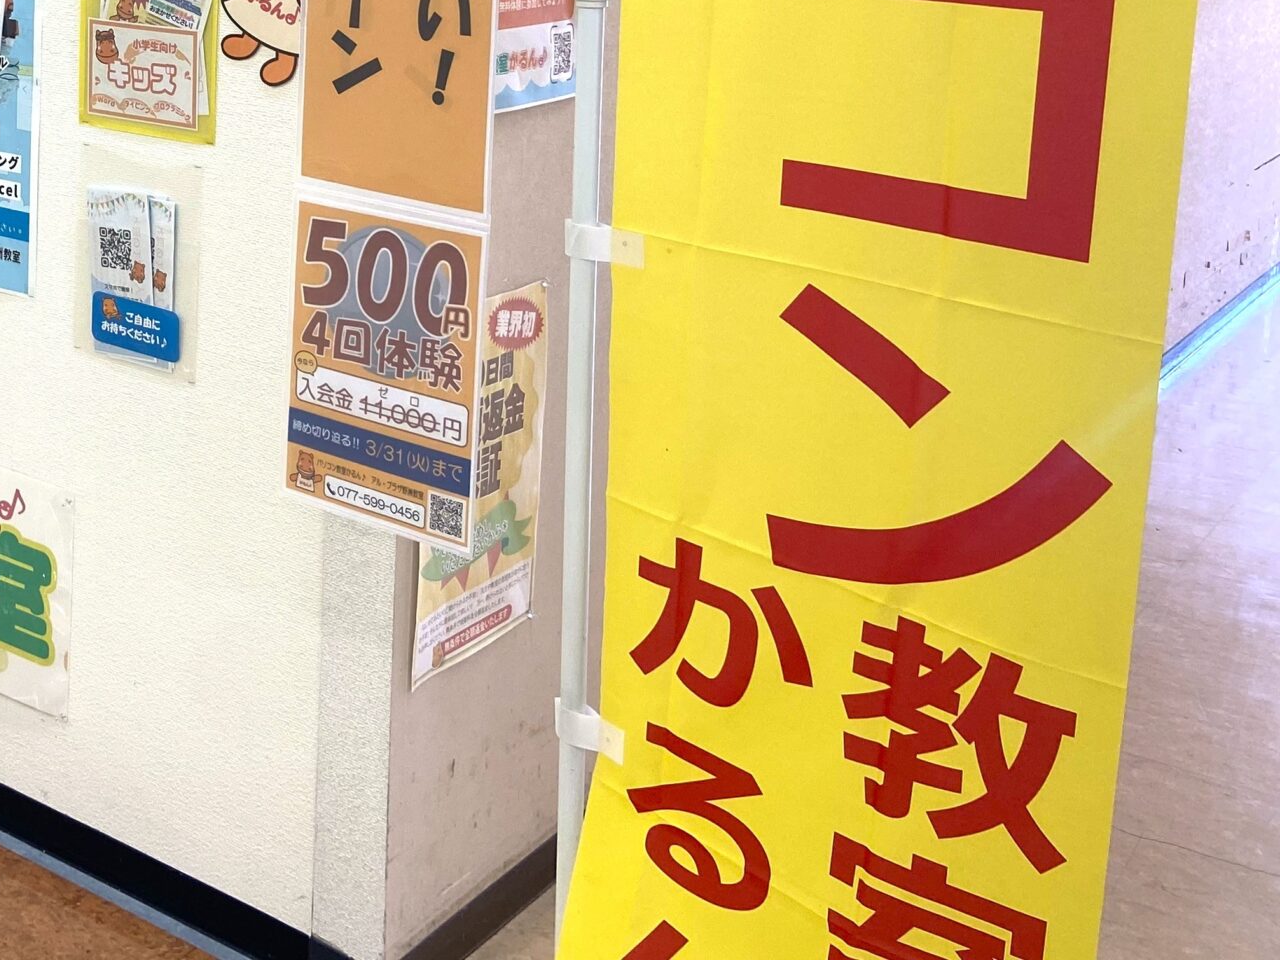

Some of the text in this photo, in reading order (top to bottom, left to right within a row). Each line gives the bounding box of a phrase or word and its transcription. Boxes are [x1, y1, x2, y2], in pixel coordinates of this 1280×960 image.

[133, 38, 177, 54] 小学生向け
[107, 58, 177, 96] キッズ
[125, 312, 161, 331] ご自由に
[495, 309, 537, 338] 業界初
[297, 357, 315, 368] 今なら
[301, 310, 463, 393] 4回体験
[299, 377, 353, 411] 入会金
[336, 484, 421, 523] 077-599-0456
[621, 537, 813, 960] かる
